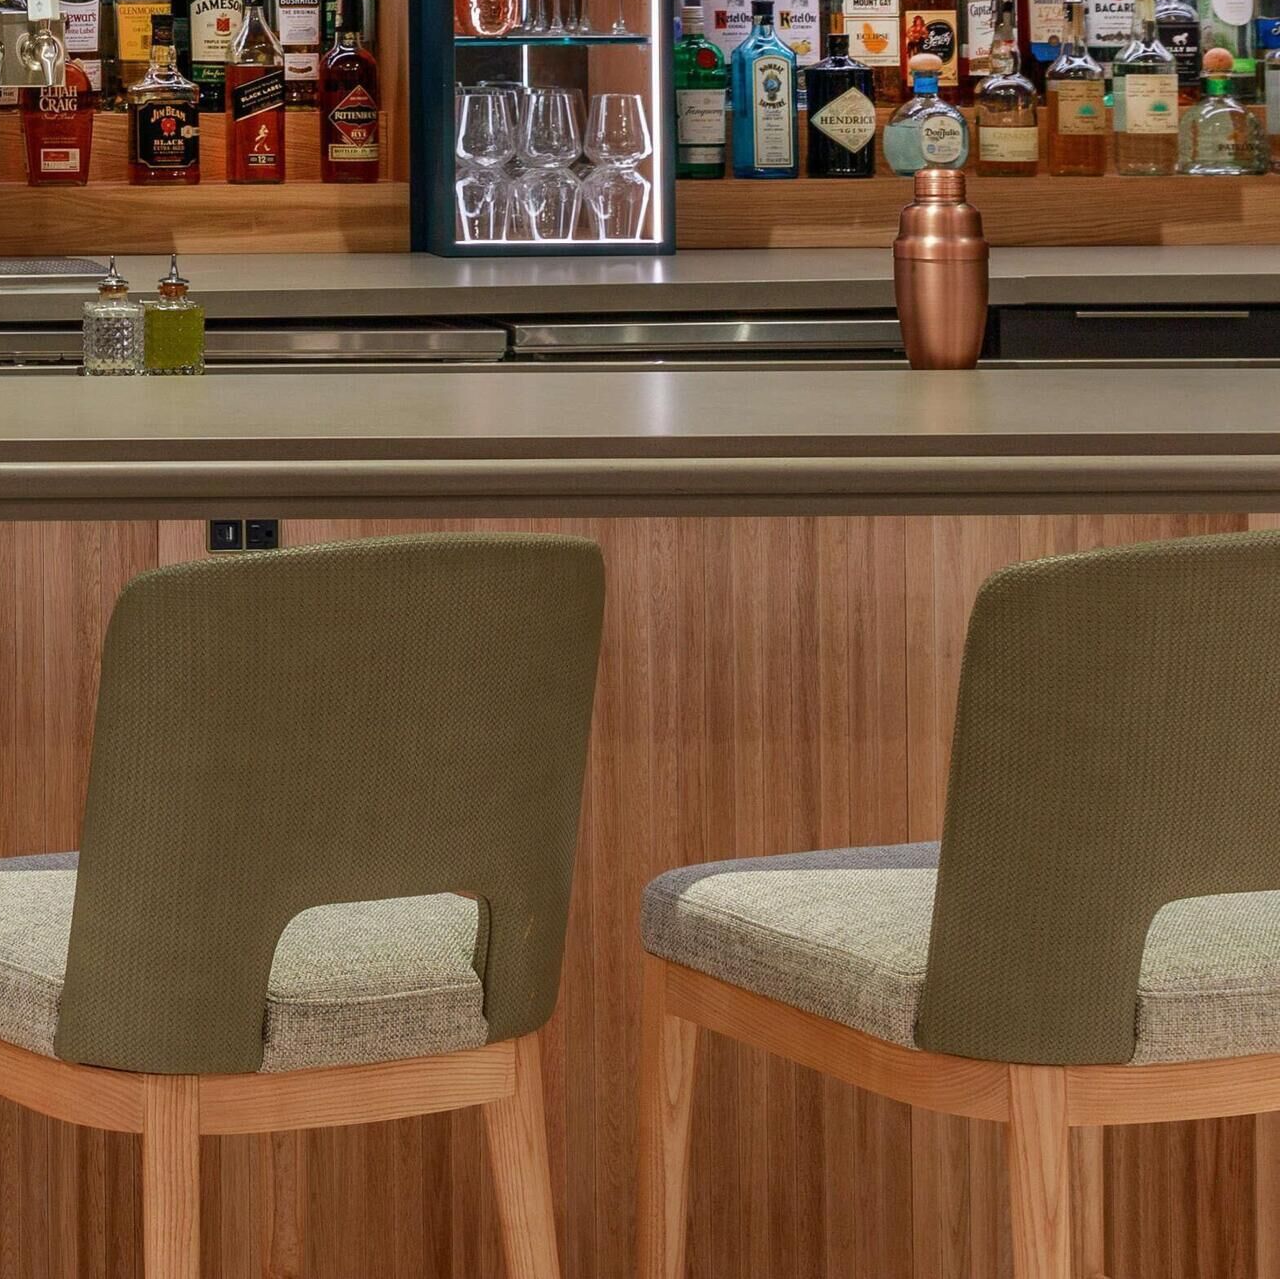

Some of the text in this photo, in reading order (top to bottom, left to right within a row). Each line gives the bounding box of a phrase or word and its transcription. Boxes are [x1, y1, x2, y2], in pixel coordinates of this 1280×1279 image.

[67, 11, 97, 22] ewar's
[970, 3, 992, 17] Capta
[714, 10, 753, 29] Ketel One
[779, 10, 804, 29] Ketel
[78, 27, 94, 35] Label
[759, 63, 784, 75] BOMBAY
[40, 85, 78, 98] ELIJAH
[240, 91, 262, 103] BLACK
[262, 83, 283, 96] LABEL
[40, 98, 78, 113] CRAIG
[150, 106, 186, 123] JIM BEAM
[256, 155, 266, 164] 12
